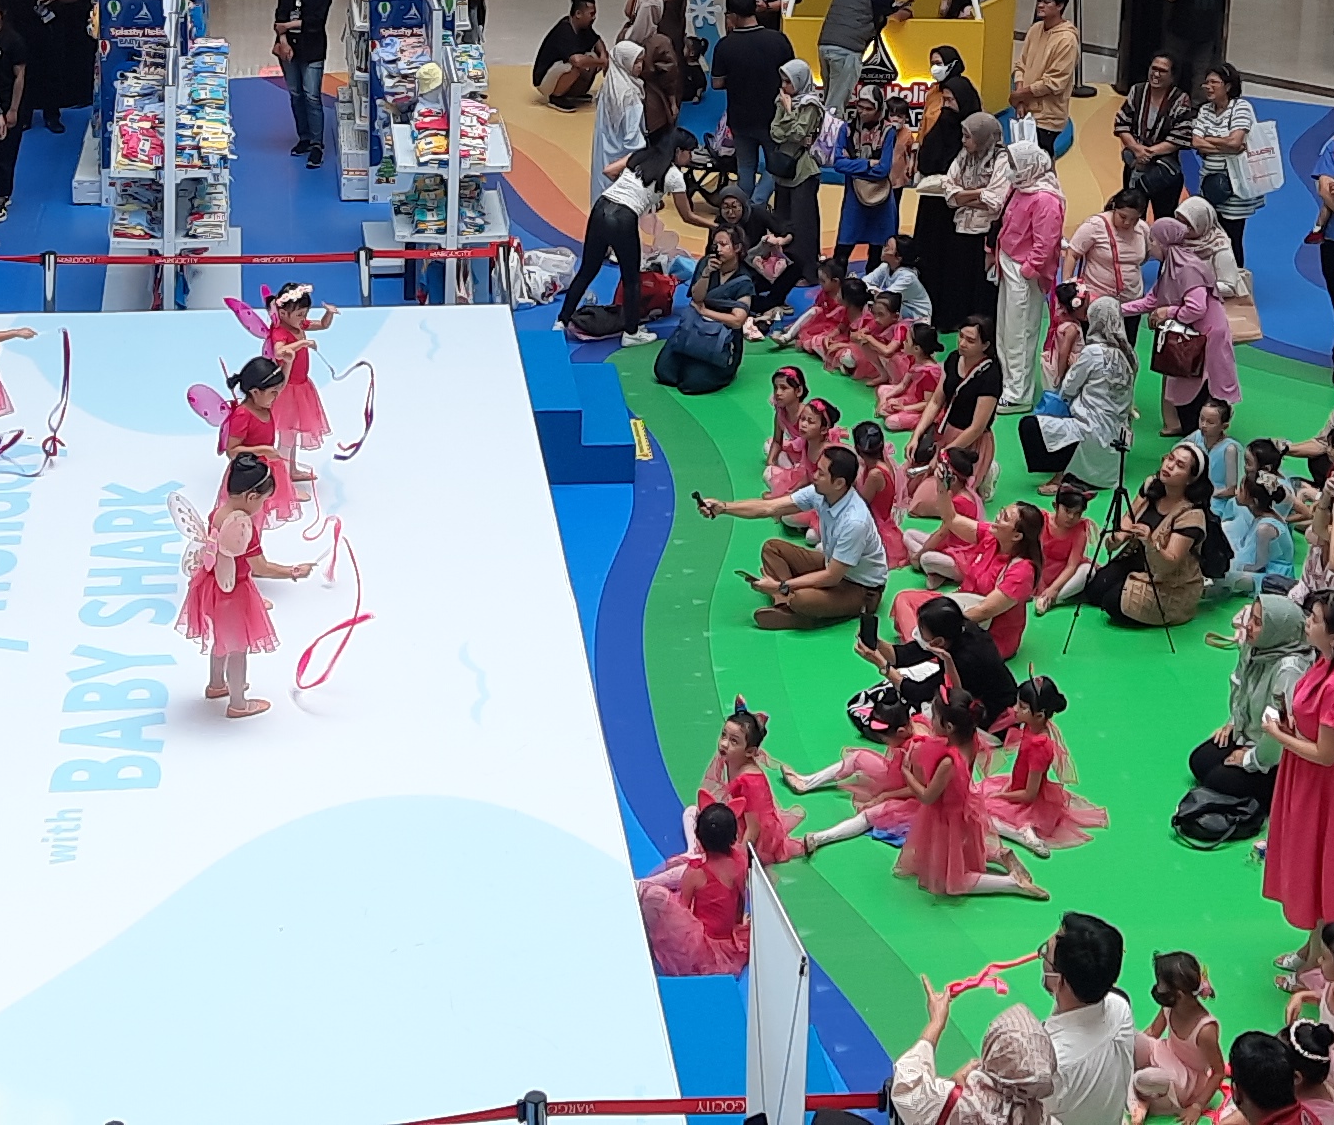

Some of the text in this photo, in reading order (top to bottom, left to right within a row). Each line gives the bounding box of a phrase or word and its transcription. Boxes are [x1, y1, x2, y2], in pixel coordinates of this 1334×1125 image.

[887, 85, 928, 105] Holi
[40, 480, 186, 865] with BABY SHARK
